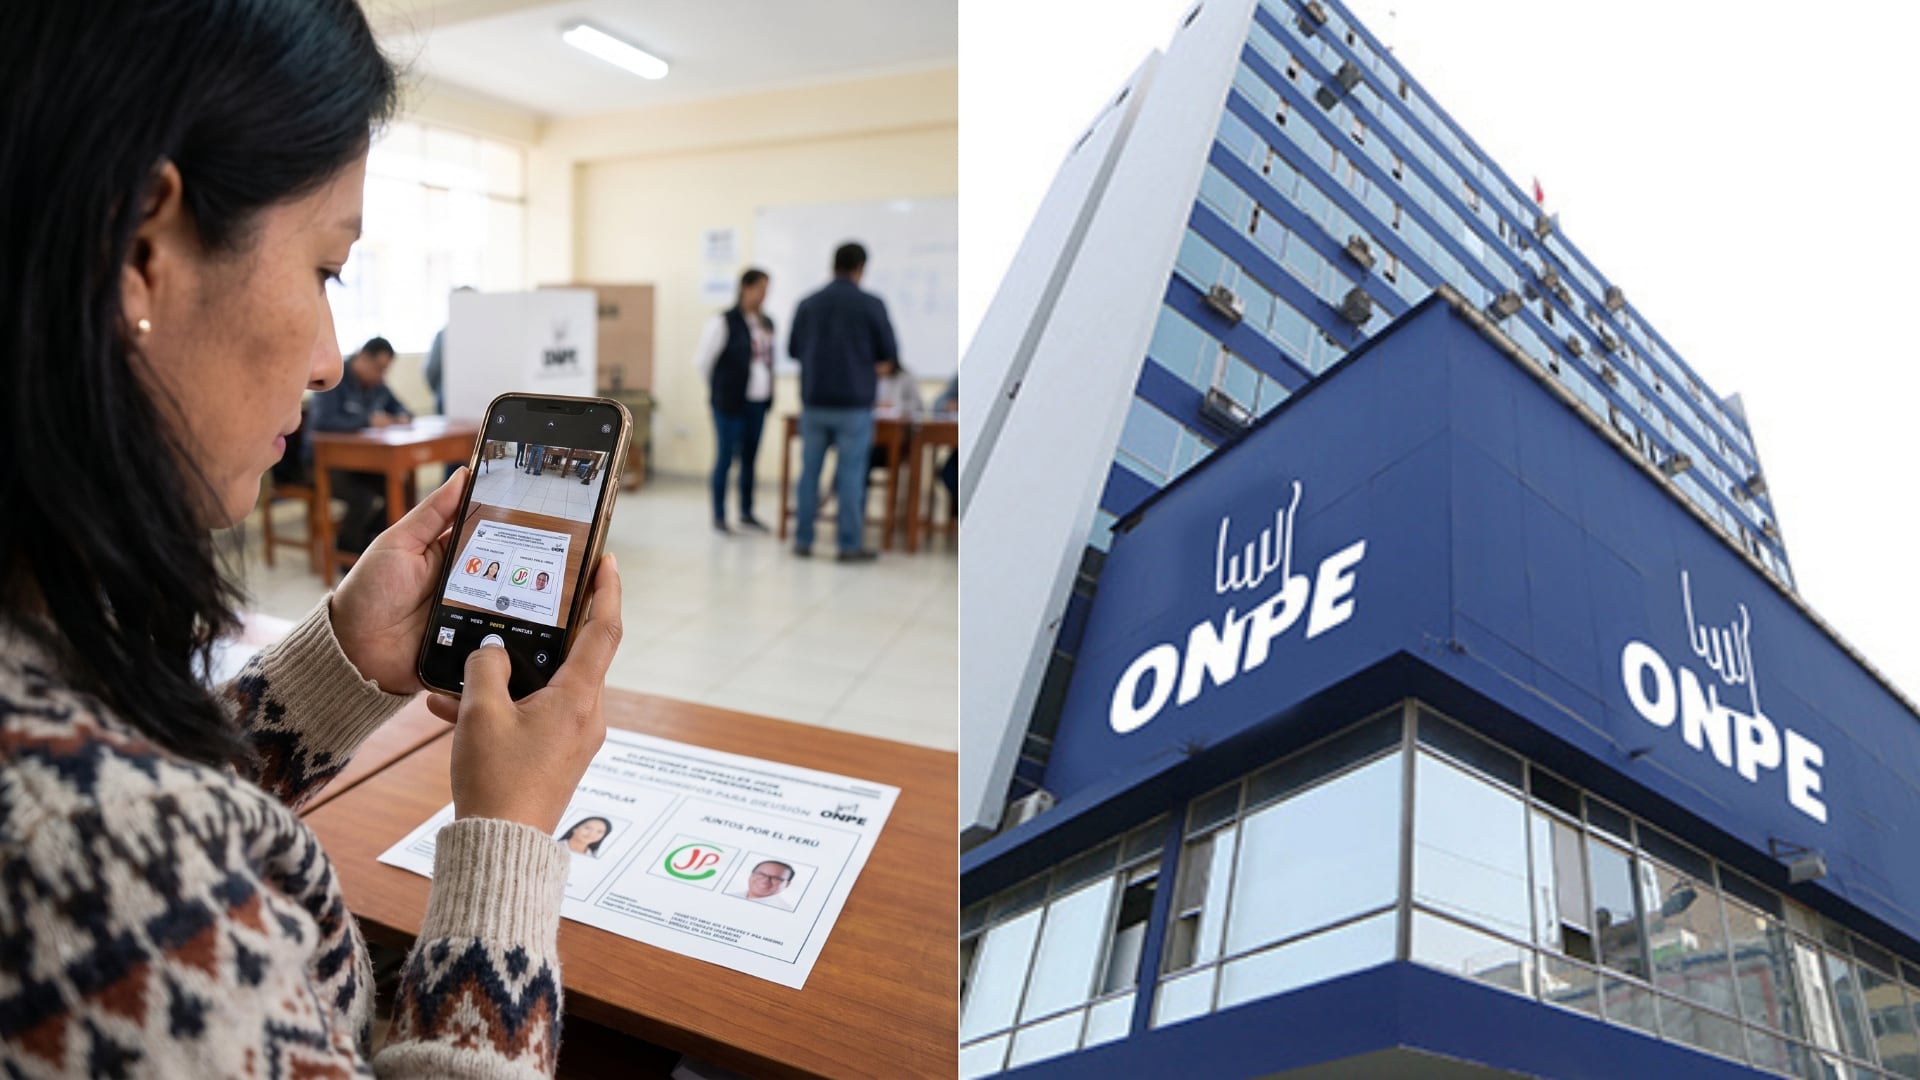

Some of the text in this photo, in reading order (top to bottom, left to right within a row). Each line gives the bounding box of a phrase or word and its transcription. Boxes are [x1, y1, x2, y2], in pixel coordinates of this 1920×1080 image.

[1109, 539, 1366, 734] ONPE
[1621, 639, 1827, 824] ONPE
[700, 815, 820, 848] JUNTOS POR EL PERÚ
[820, 809, 868, 826] ONPE
[673, 848, 720, 871] JP
